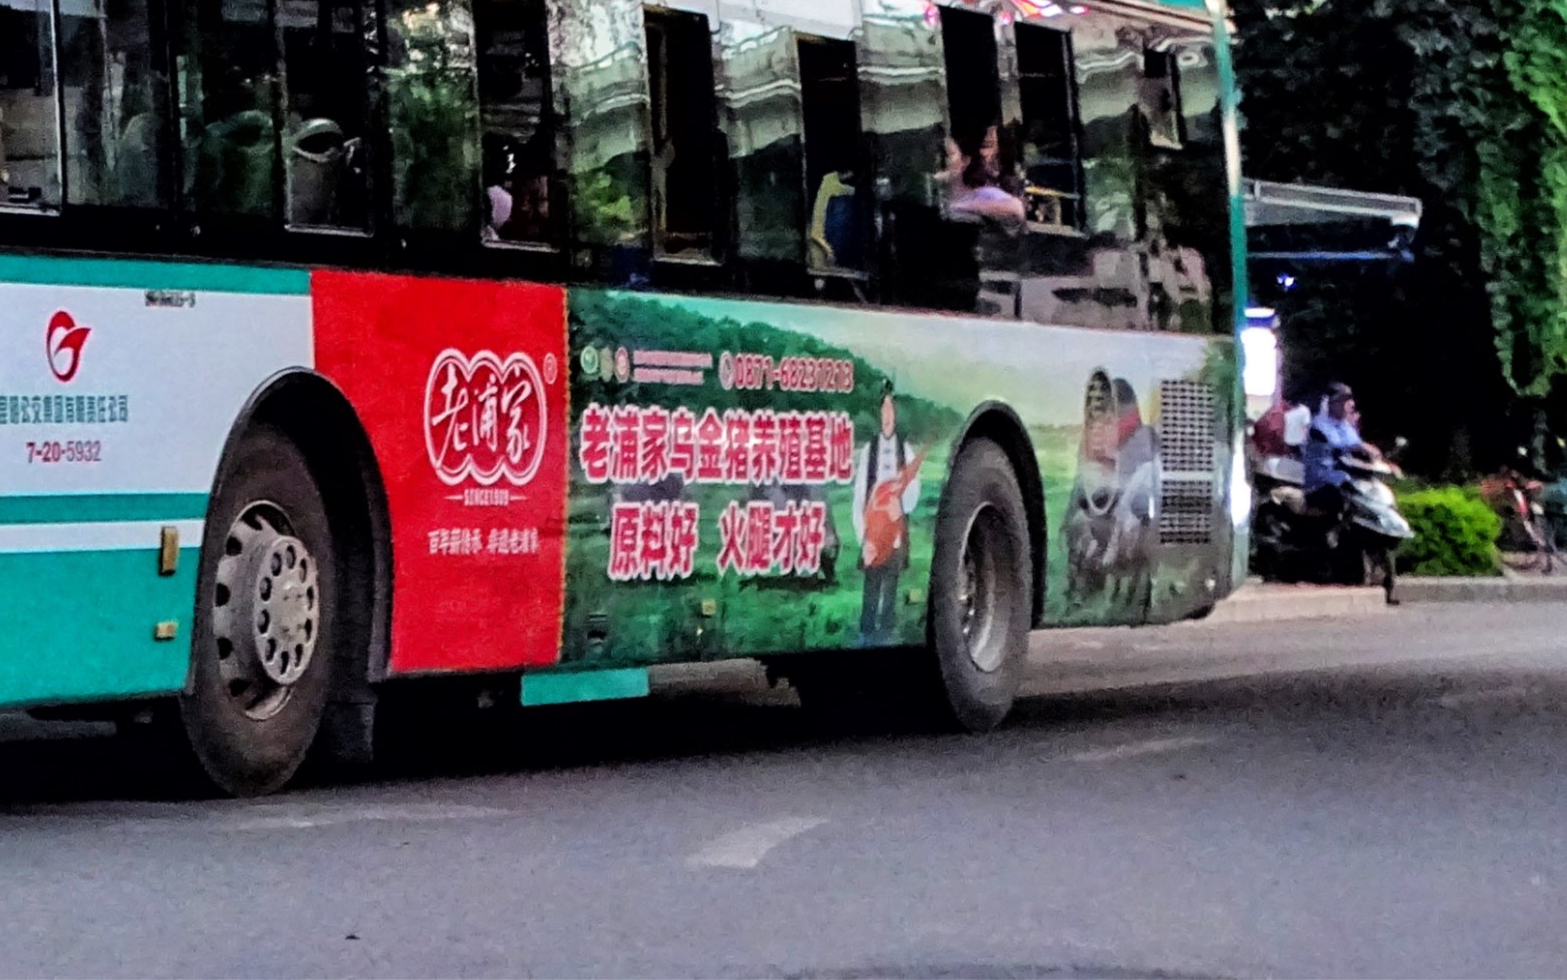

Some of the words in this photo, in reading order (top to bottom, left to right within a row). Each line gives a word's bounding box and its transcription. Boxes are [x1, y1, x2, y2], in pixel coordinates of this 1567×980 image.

[579, 403, 855, 485] 老浦家乌金猪养殖基地
[608, 499, 699, 580] 原料好
[717, 499, 826, 577] 火腿才好
